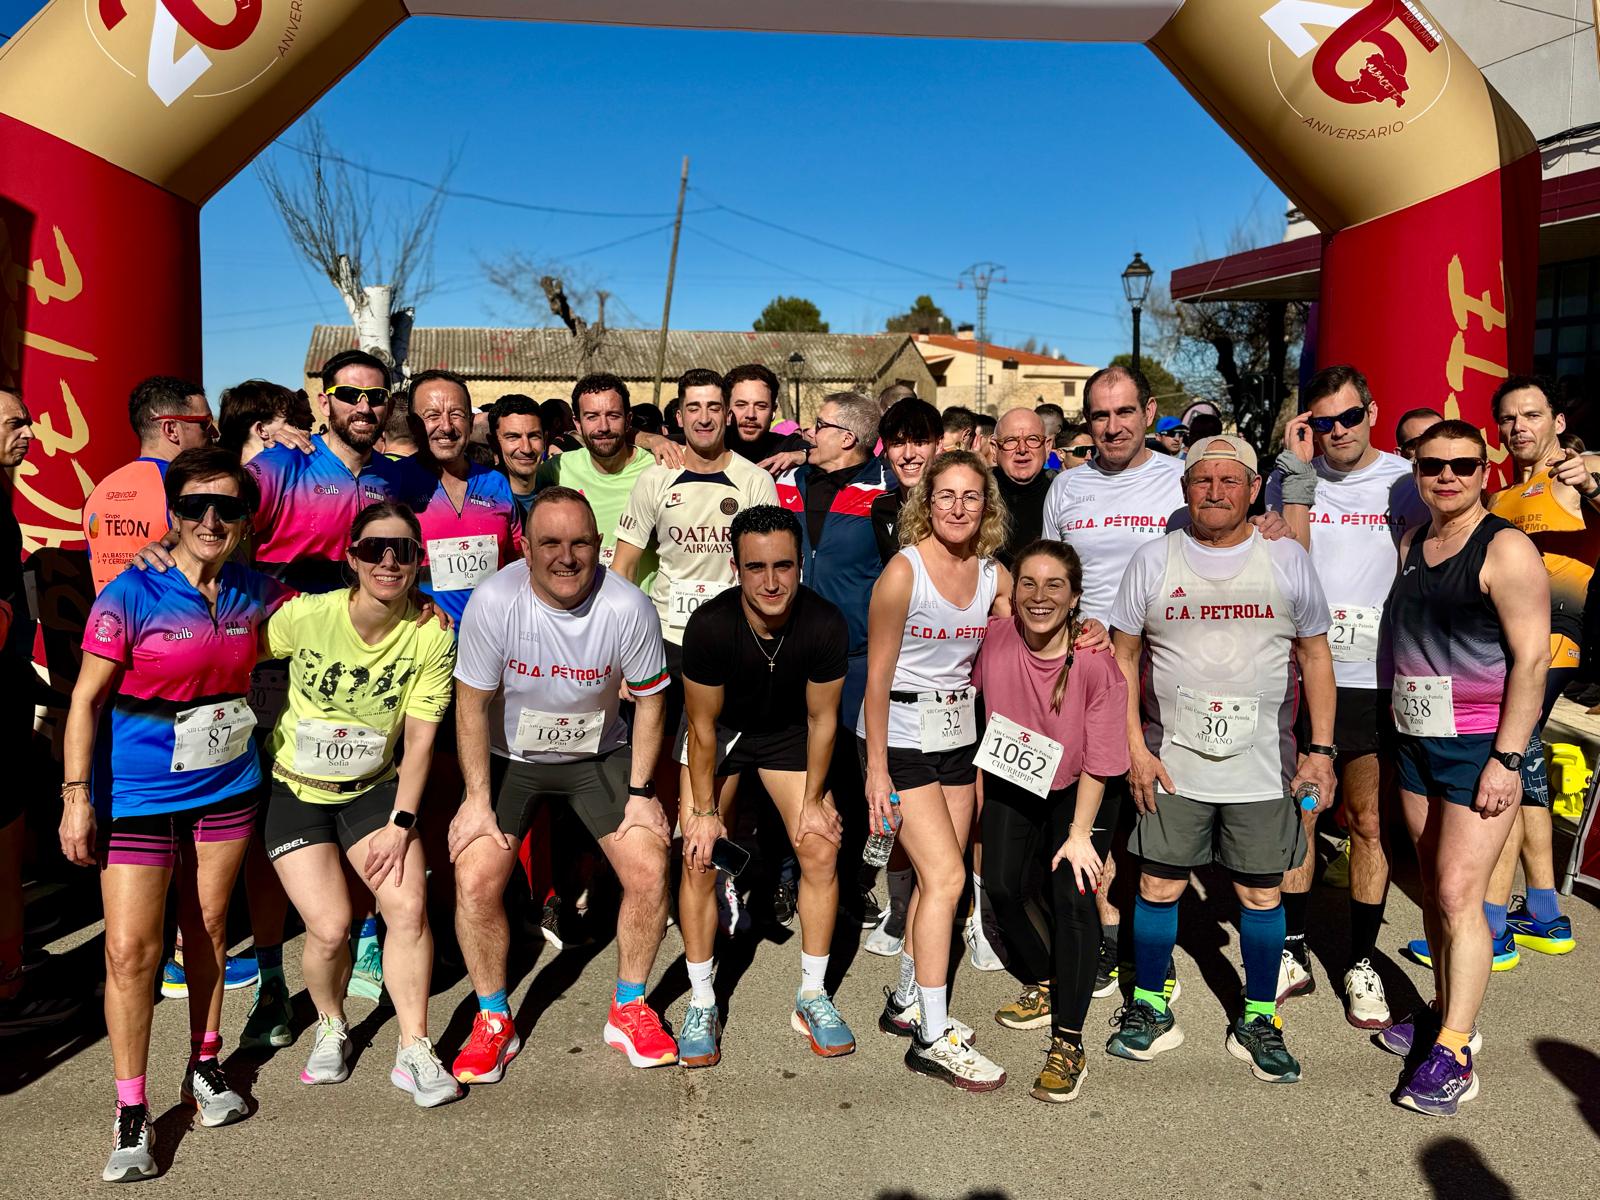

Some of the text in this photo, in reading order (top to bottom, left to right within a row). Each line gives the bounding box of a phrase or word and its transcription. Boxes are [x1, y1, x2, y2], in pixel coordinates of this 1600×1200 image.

[1302, 117, 1405, 141] ANIVERSARIO
[105, 520, 150, 538] TECON
[1103, 514, 1168, 528] PÉTROLA
[668, 526, 732, 545] QATAR
[683, 543, 733, 554] AIRWAYS
[448, 554, 487, 573] 1026
[1165, 604, 1275, 620] C.A. PETROLA
[911, 625, 951, 640] C.D.A.
[1333, 625, 1355, 645] 21
[508, 659, 613, 681] C.D.A. PÉTROLA
[1402, 697, 1431, 717] 238
[944, 710, 960, 730] 32
[1201, 716, 1228, 738] 30
[208, 725, 232, 748] 87
[537, 728, 587, 742] 1039
[1195, 732, 1233, 745] ATILANO
[208, 745, 230, 756] Elvira
[314, 742, 368, 760] 1007
[989, 737, 1047, 779] 1062
[992, 759, 1034, 784] CHURRIPIPI
